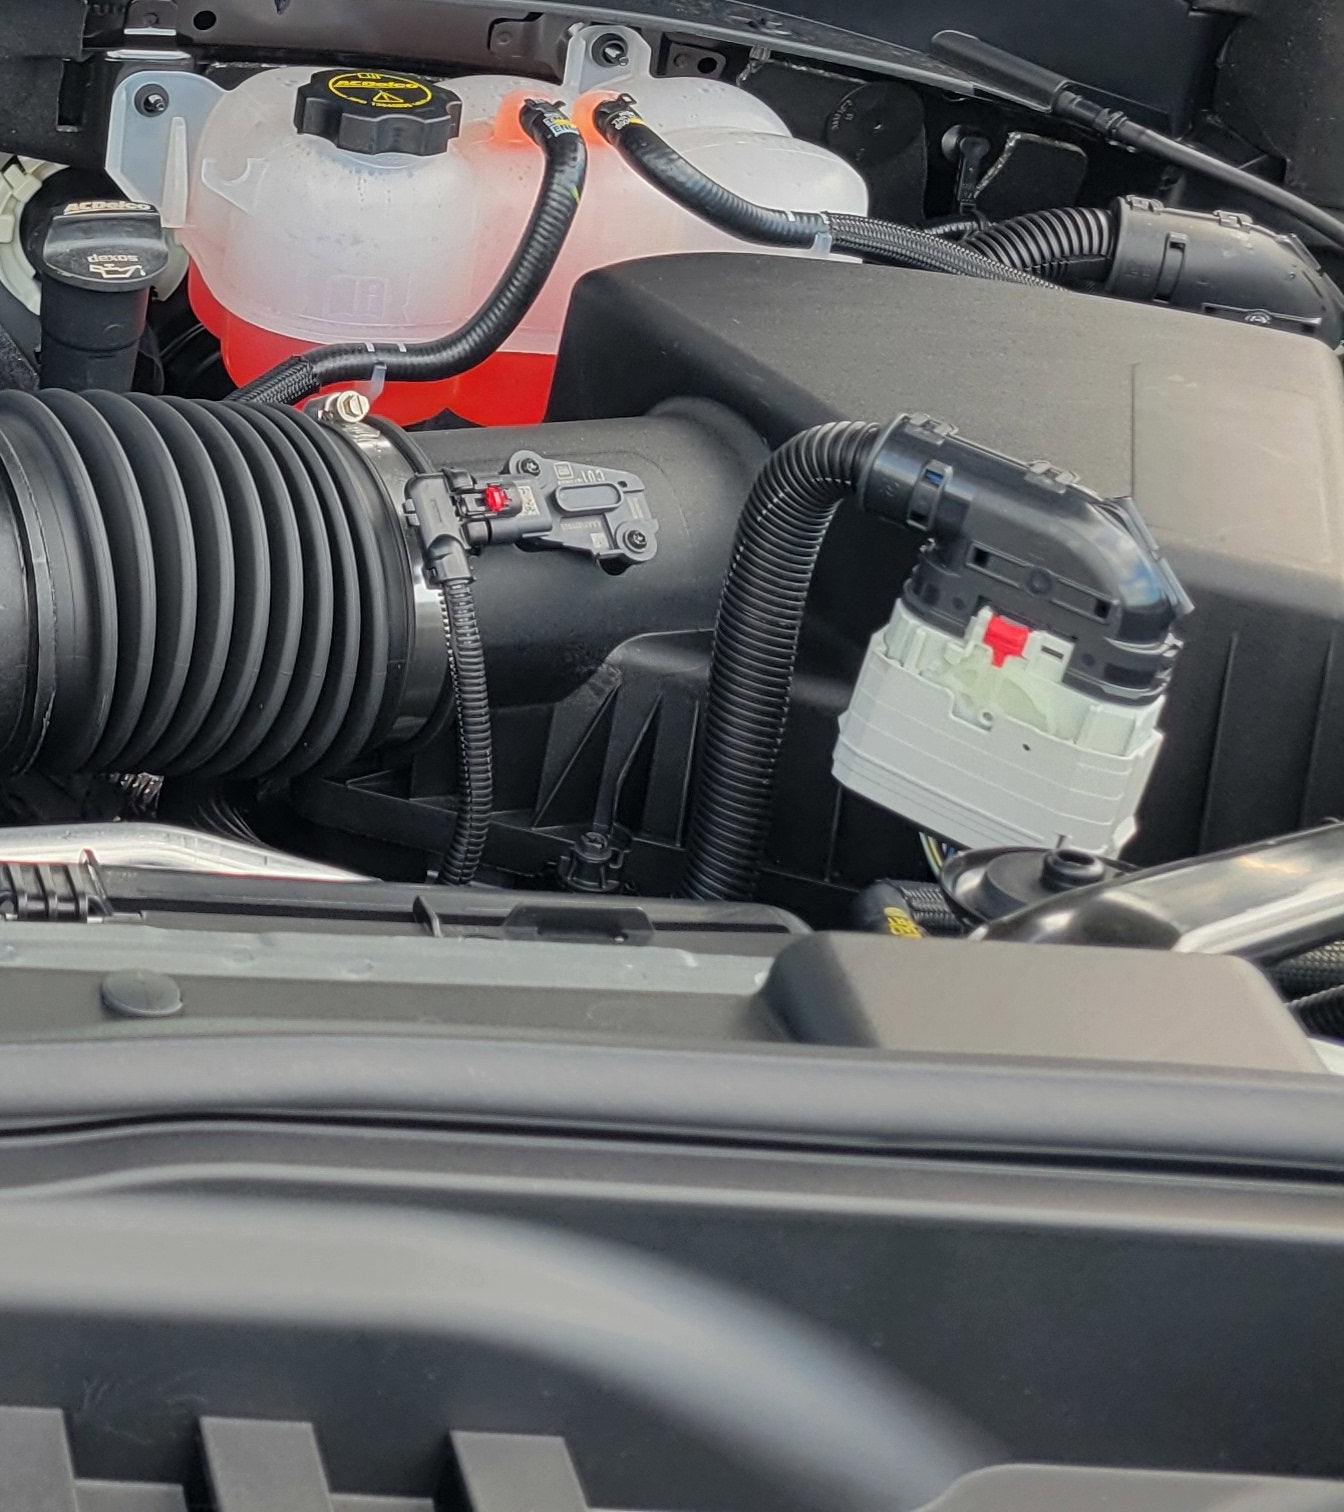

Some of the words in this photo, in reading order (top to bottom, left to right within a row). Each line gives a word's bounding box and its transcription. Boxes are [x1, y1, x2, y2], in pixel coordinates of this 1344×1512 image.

[333, 80, 419, 89] ACDelco
[64, 201, 152, 213] ACDelco
[87, 253, 140, 263] dexos
